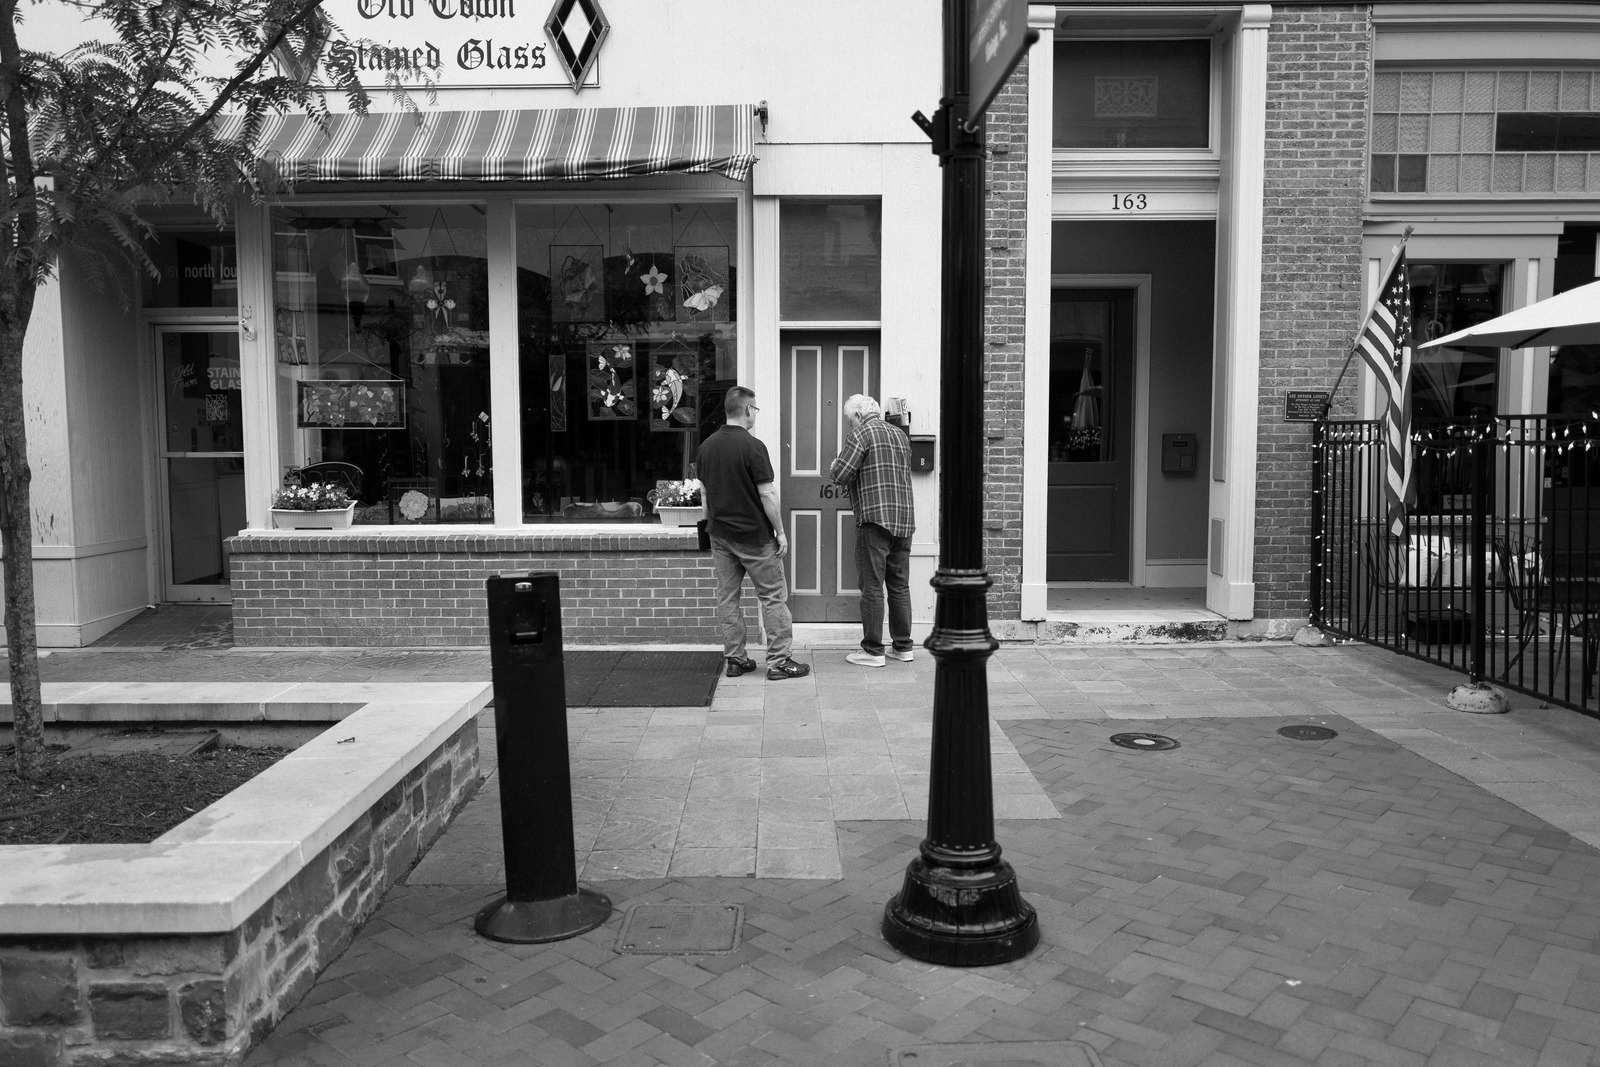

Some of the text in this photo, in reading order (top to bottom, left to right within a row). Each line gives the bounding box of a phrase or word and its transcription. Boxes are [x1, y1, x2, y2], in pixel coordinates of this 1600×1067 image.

[328, 38, 547, 71] Stained Glass
[1112, 193, 1147, 210] 163
[184, 263, 215, 279] north
[171, 362, 195, 380] Old
[170, 378, 198, 396] Town
[920, 457, 926, 466] B
